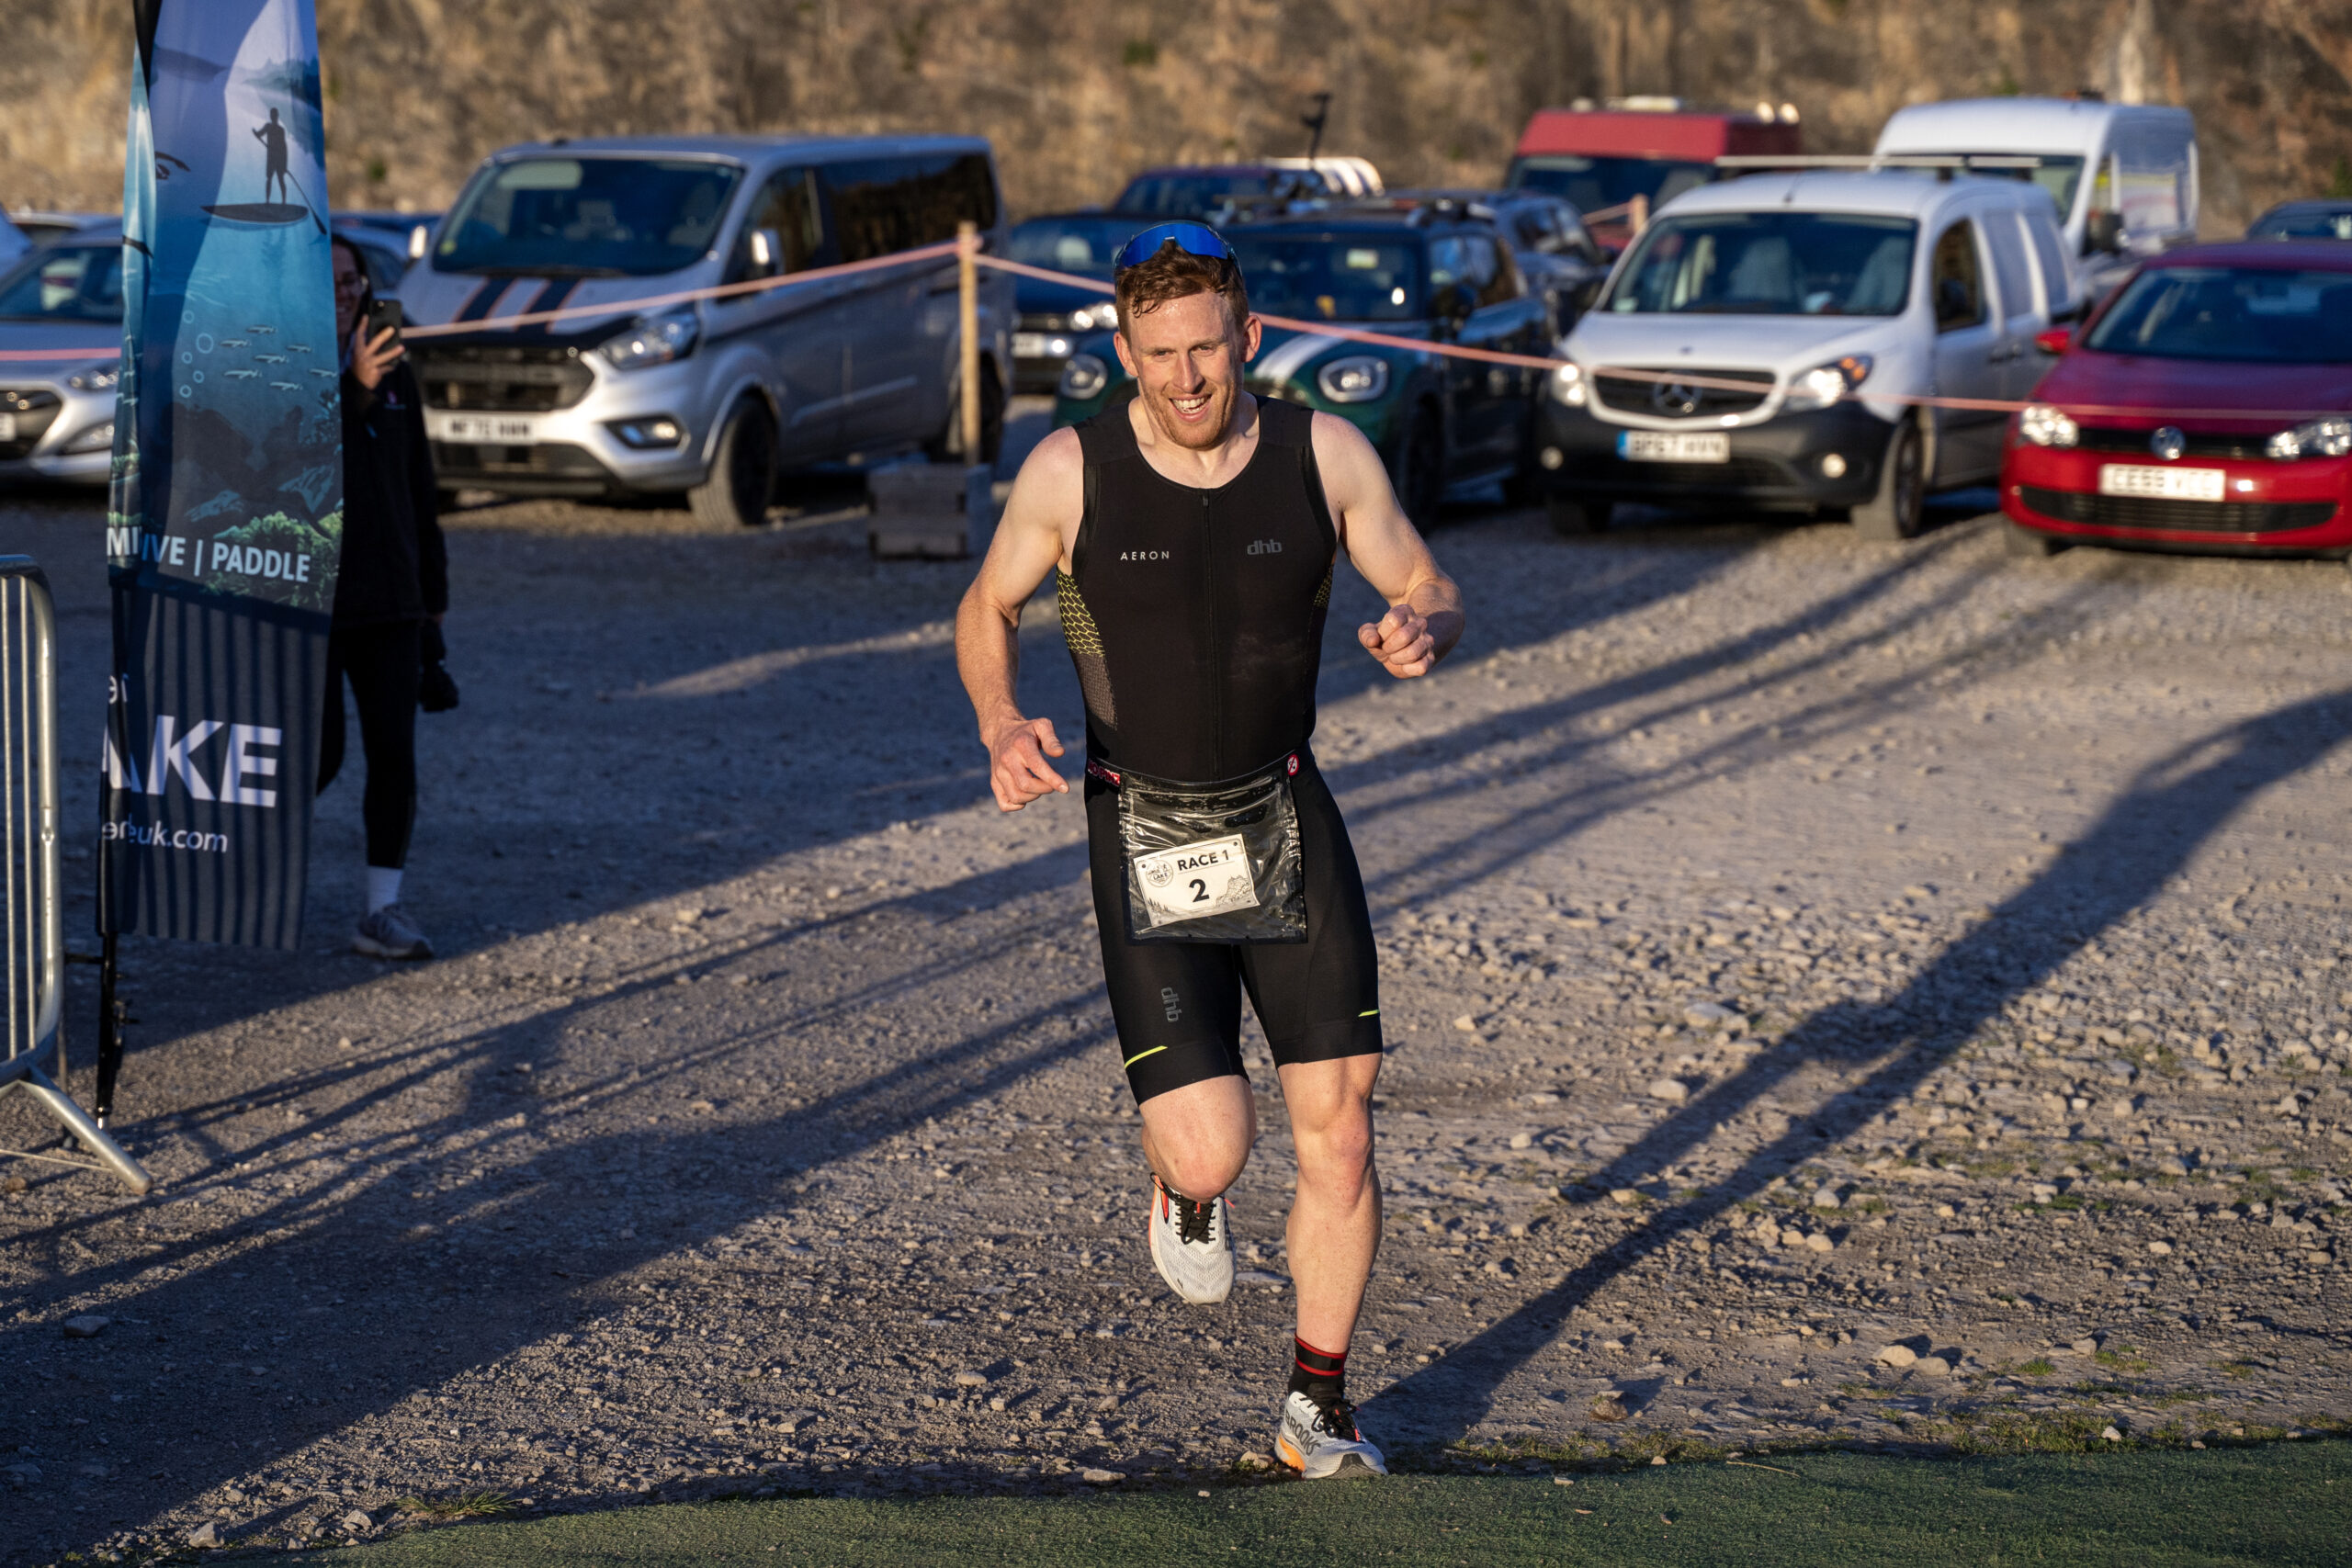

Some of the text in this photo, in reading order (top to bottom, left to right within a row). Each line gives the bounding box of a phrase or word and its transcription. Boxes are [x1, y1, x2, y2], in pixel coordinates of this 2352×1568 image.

[1120, 550, 1170, 561] AERON
[1247, 538, 1283, 555] dhb
[211, 541, 311, 583] PADDLE
[1177, 852, 1219, 872] RACE
[1222, 849, 1229, 862] 1
[1189, 878, 1210, 903] 2
[1160, 987, 1182, 1022] dhb
[1285, 1409, 1321, 1457] BROOKS
